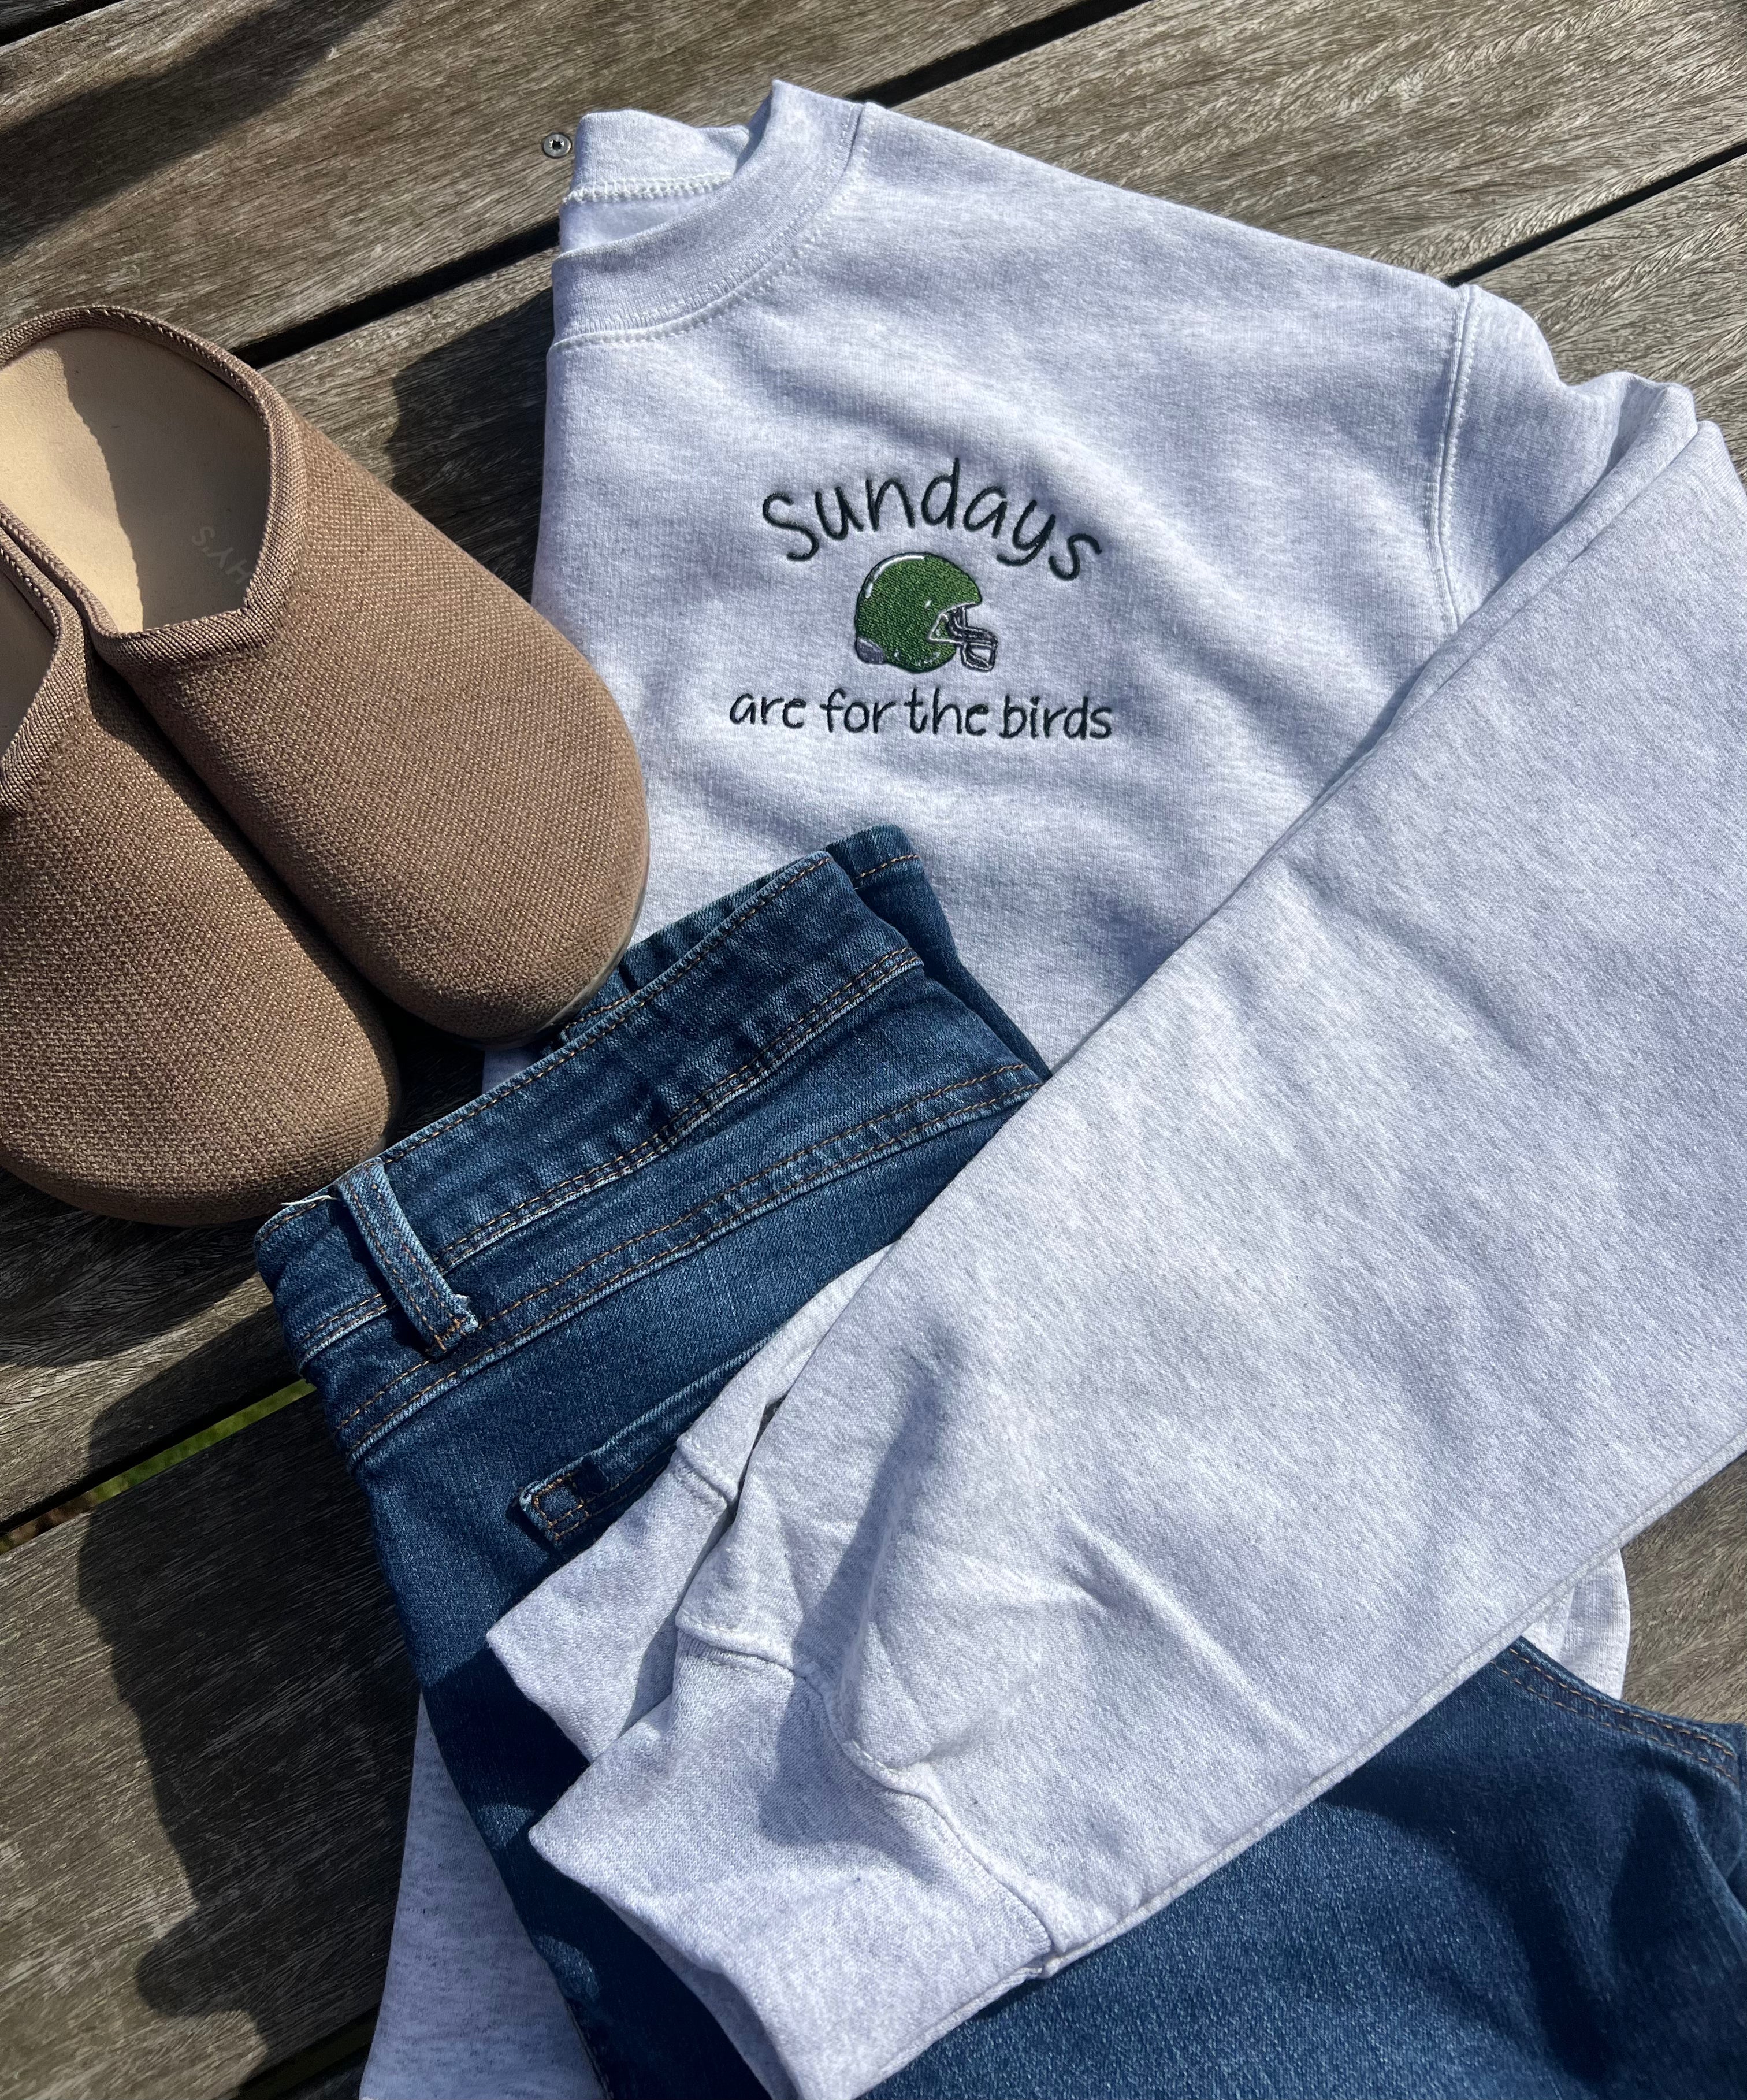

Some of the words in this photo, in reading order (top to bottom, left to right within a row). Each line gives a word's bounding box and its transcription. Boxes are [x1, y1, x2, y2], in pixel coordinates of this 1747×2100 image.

[729, 692, 807, 729] are
[819, 687, 897, 734] for
[902, 687, 989, 736] the
[998, 693, 1113, 740] birds
